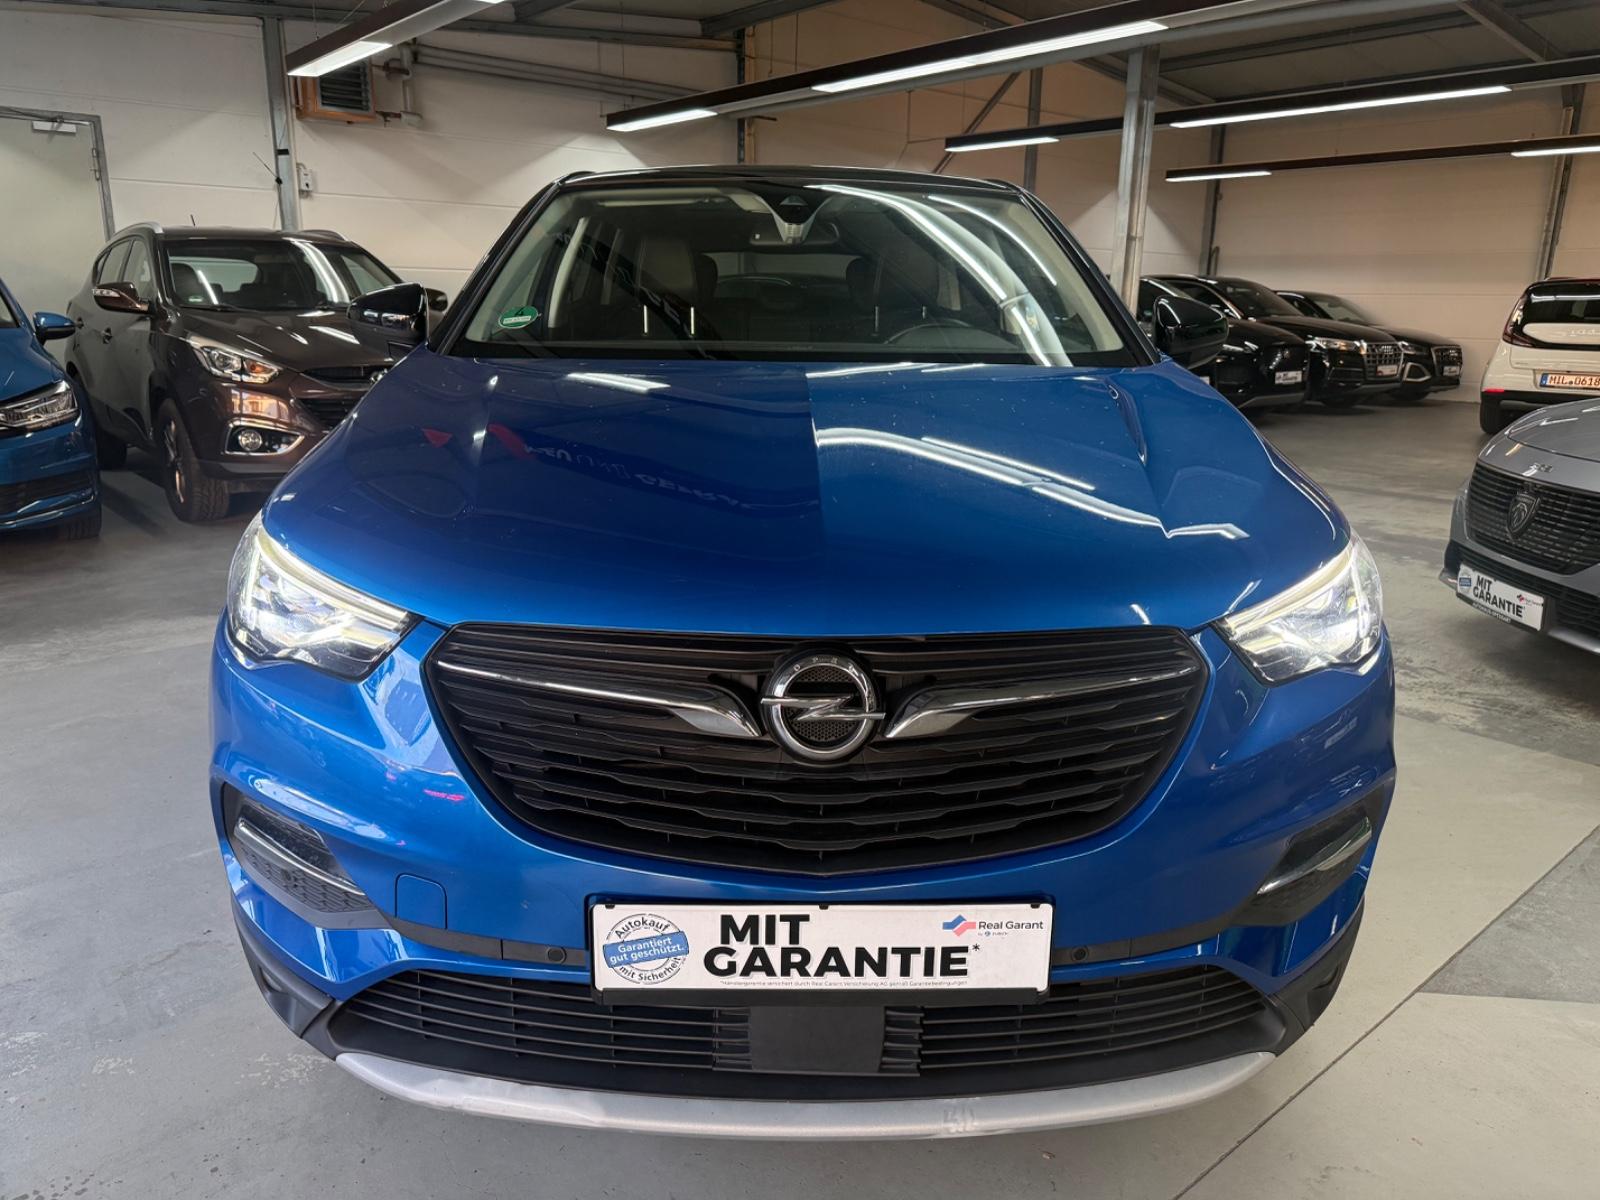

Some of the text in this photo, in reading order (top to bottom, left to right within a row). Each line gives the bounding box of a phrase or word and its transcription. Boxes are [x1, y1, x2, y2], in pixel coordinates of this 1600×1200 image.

[1476, 575, 1492, 591] MIT
[615, 916, 670, 939] Autokauf
[720, 914, 810, 945] MIT
[978, 920, 1044, 930] Real Garant
[609, 943, 686, 966] gut geschützt.
[617, 936, 672, 953] Garantiert
[619, 956, 681, 981] mit Sicherheit
